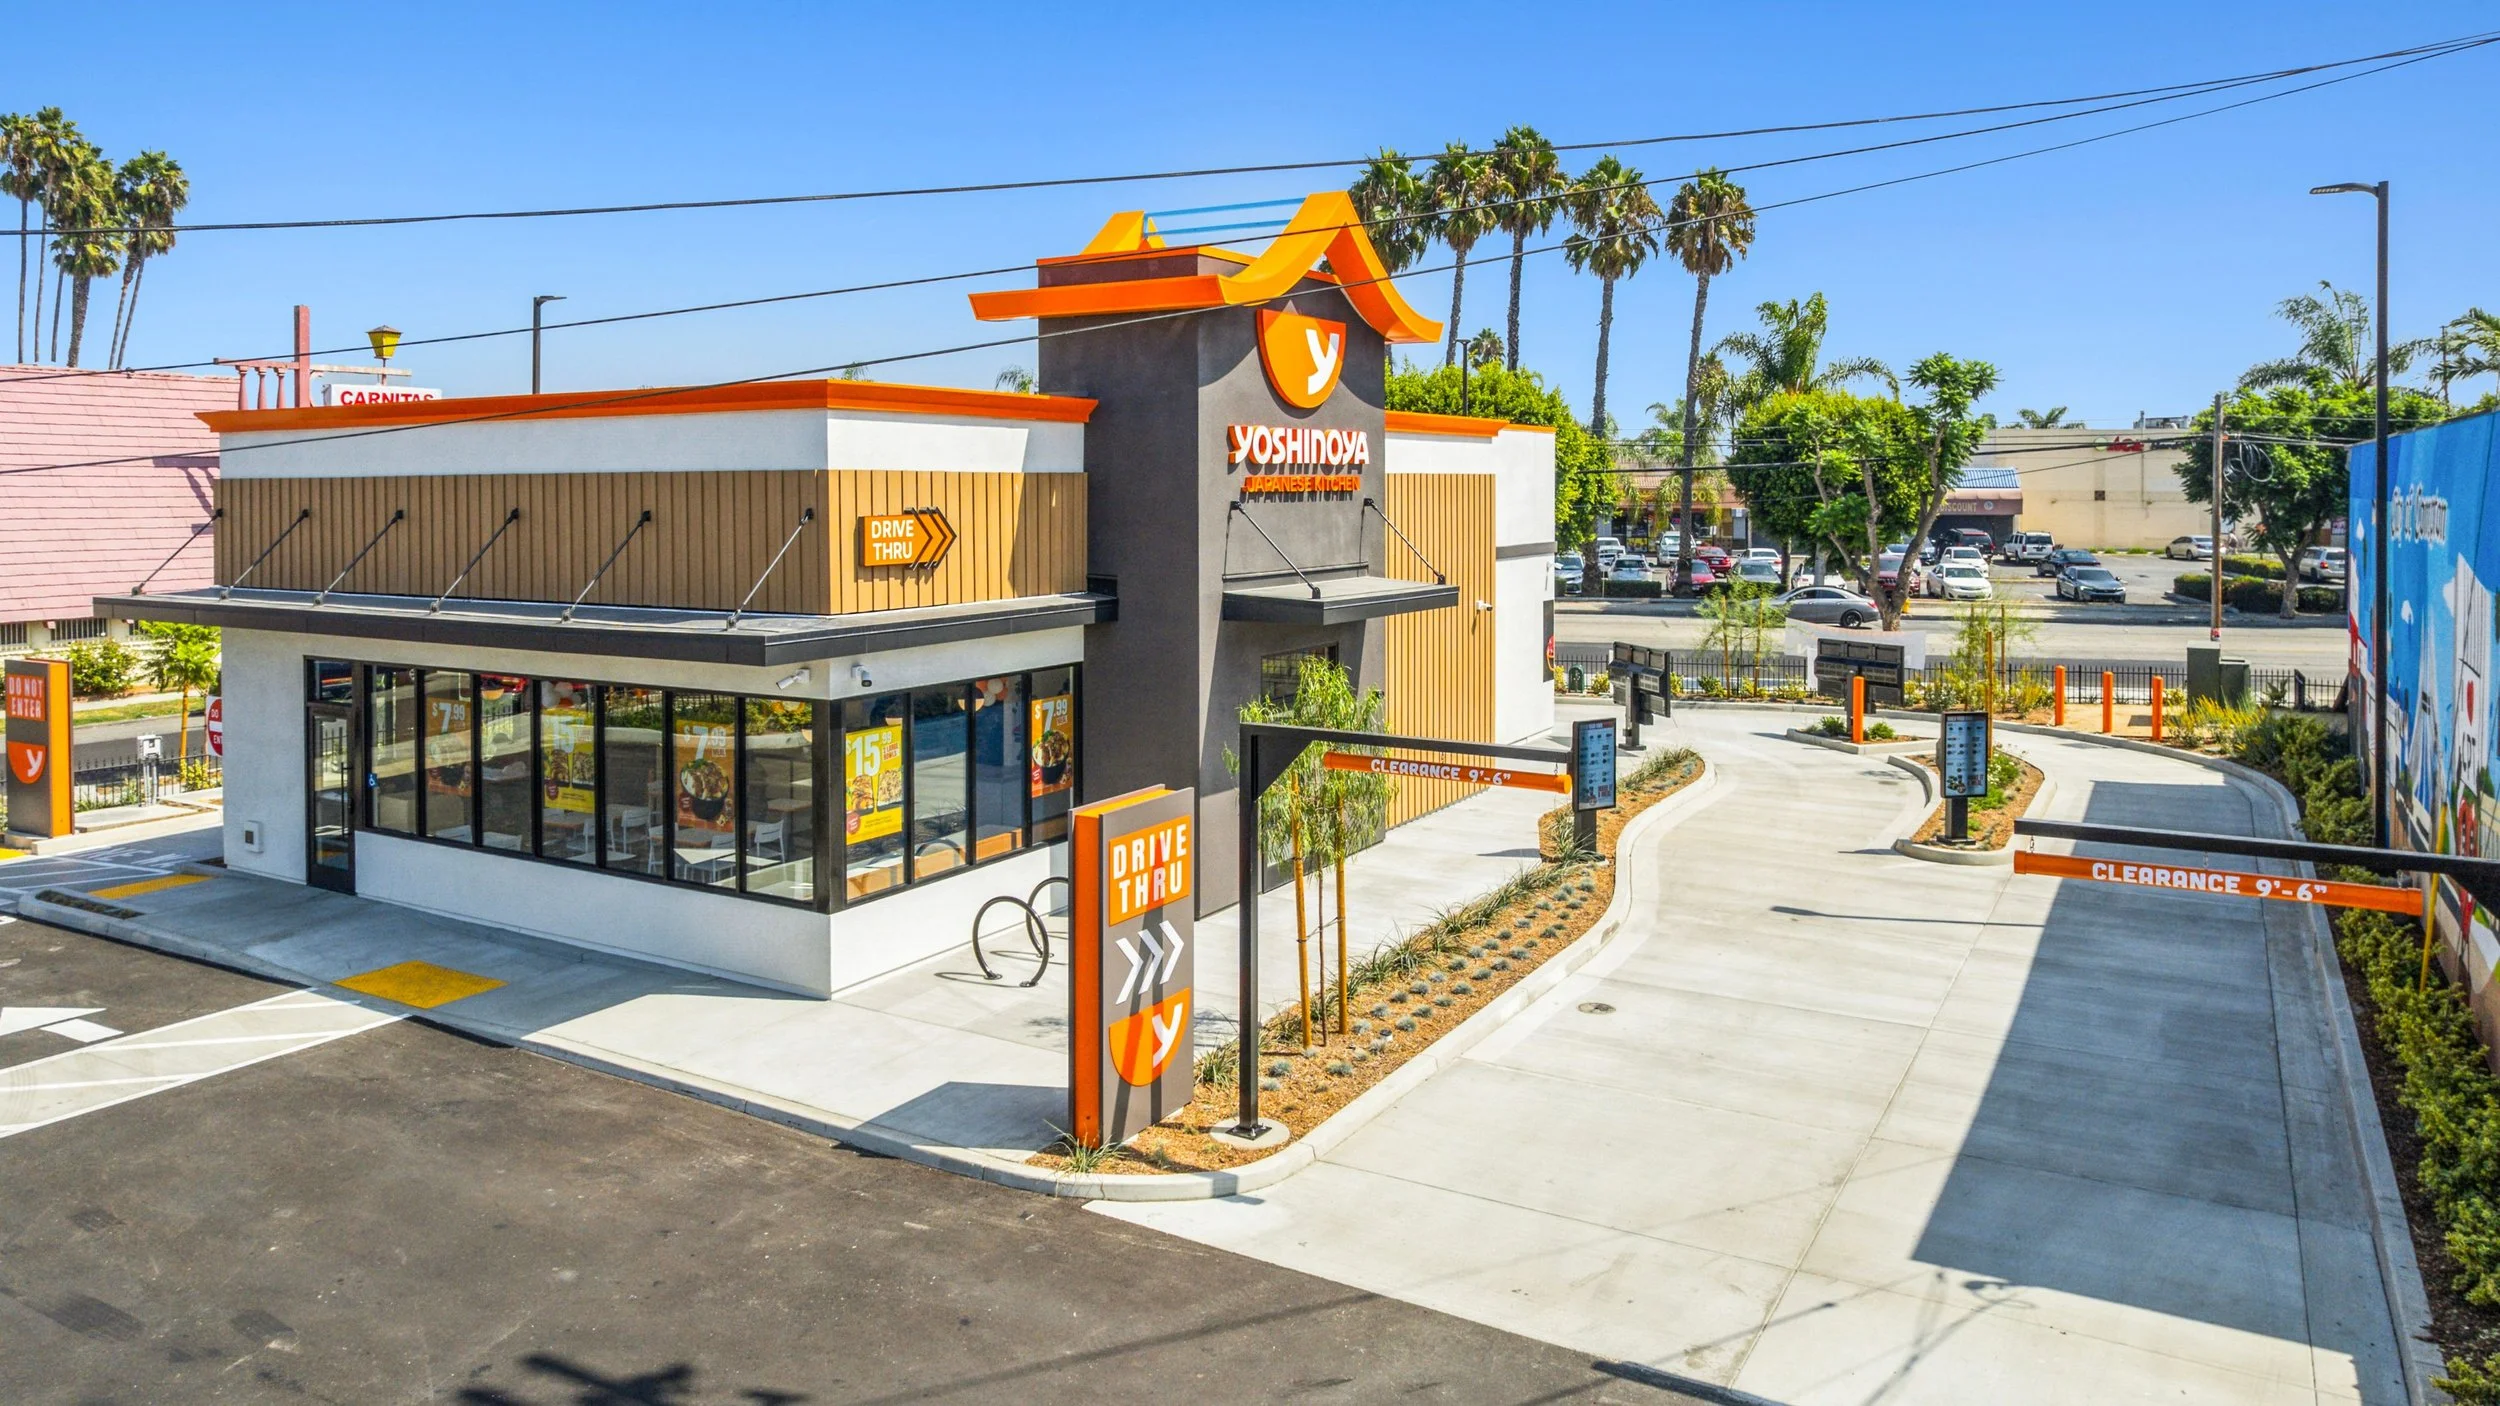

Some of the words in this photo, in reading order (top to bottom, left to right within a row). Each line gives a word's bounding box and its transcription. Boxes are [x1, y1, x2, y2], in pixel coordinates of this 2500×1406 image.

[1230, 425, 1370, 465] YOSHINOYA
[1246, 476, 1312, 493] JAPANESE
[1314, 475, 1361, 492] KITCHEN
[871, 520, 914, 539] DRIVE
[872, 541, 913, 561] THRU
[8, 676, 21, 696] DO
[24, 677, 44, 699] NOT
[11, 697, 42, 719] ENTER
[211, 708, 219, 719] DO
[1370, 758, 1461, 782] CLEARANCE
[1113, 822, 1188, 881] DRIVE
[1119, 860, 1183, 915] THRU
[2092, 862, 2241, 895] CLEARANCE
